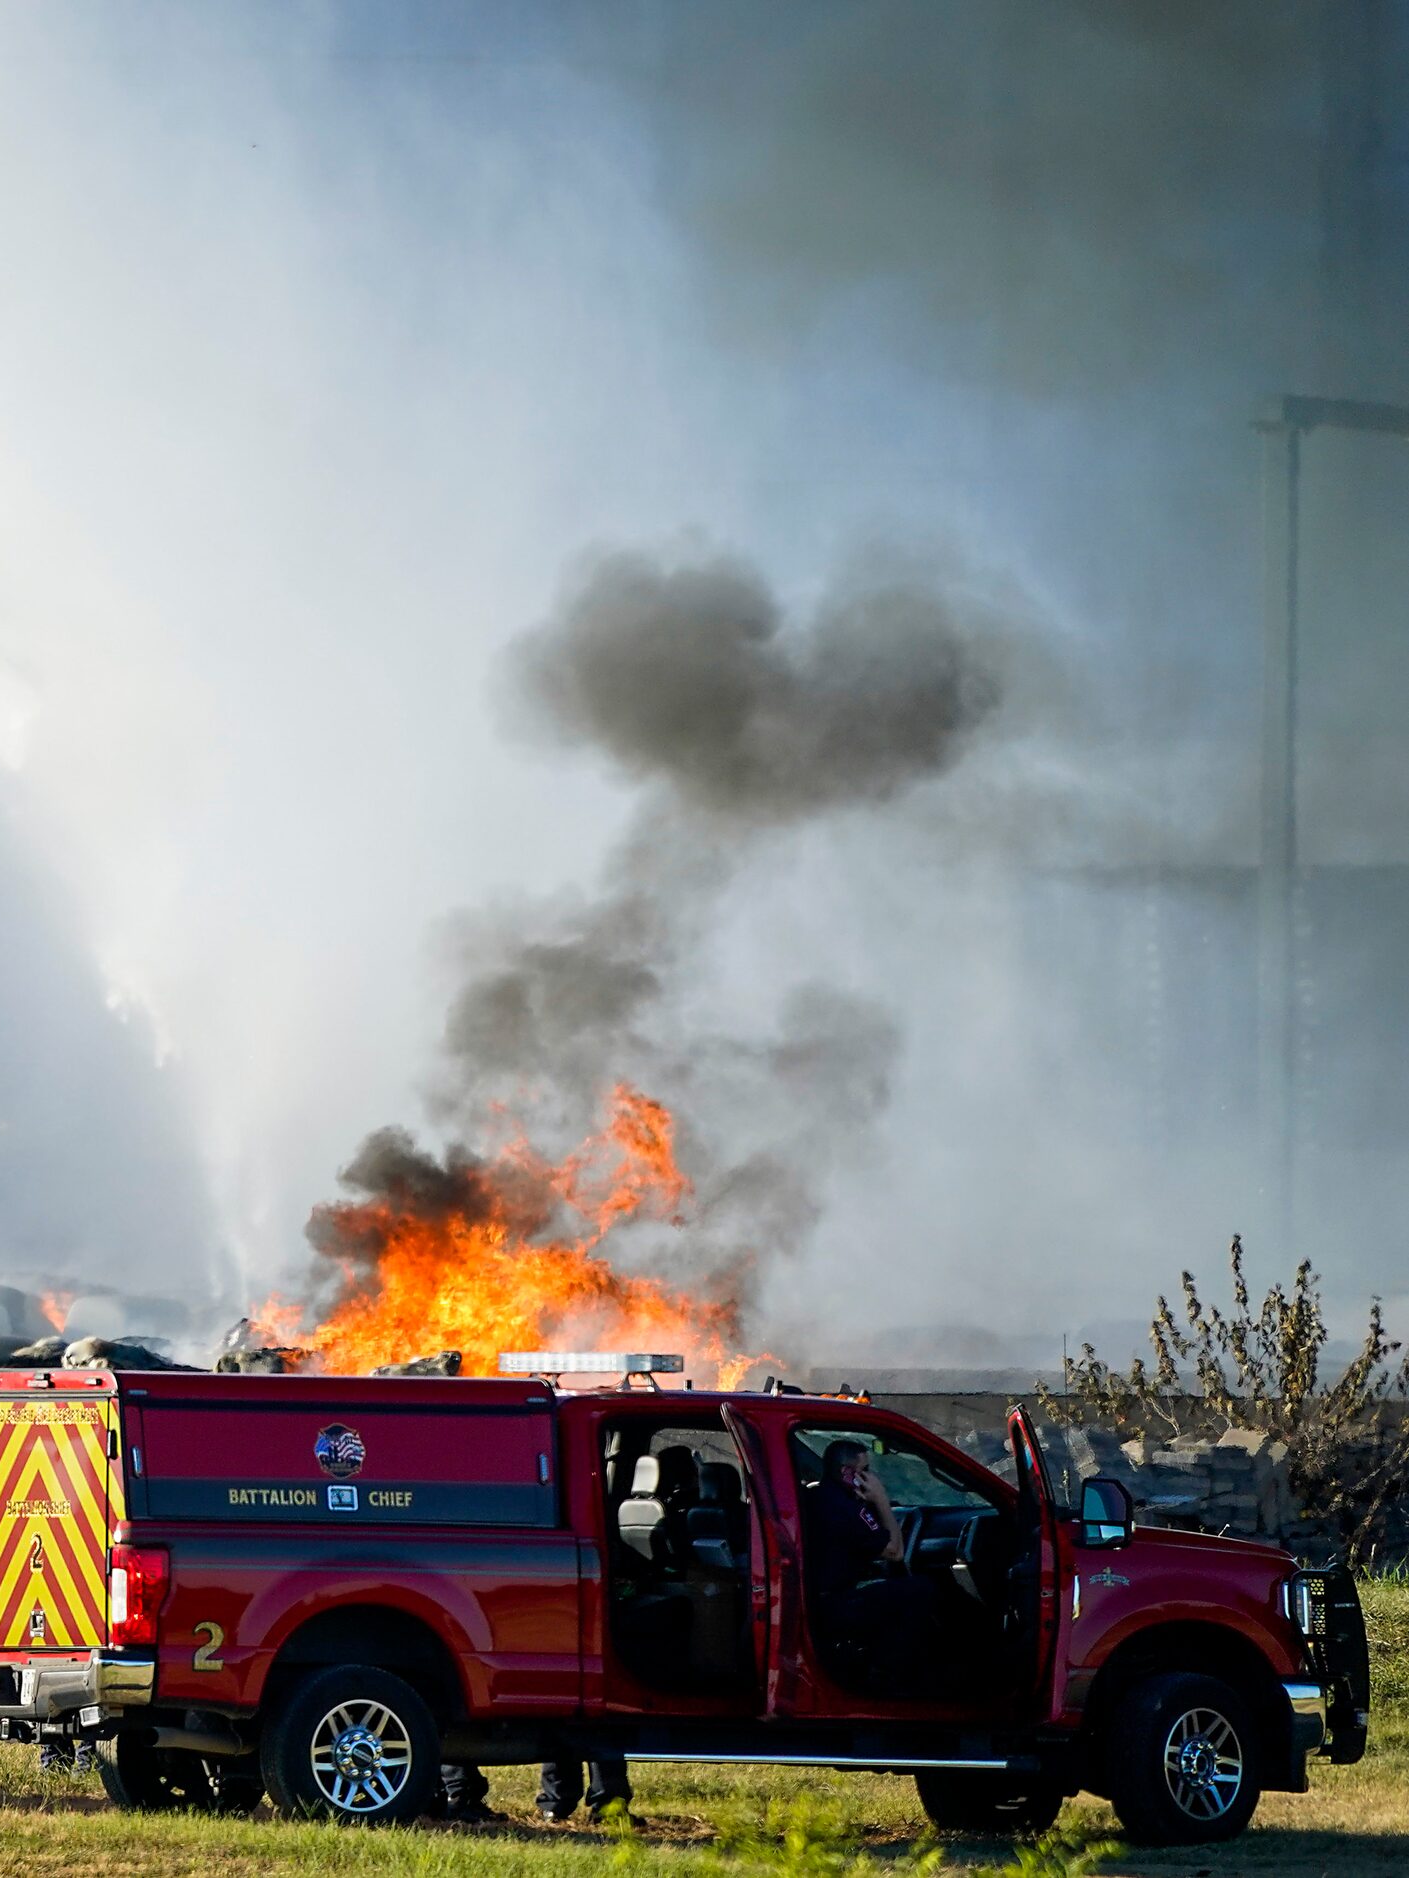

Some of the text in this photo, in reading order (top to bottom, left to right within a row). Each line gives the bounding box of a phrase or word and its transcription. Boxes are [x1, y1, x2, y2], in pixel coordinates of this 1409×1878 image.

[229, 1488, 413, 1507] BATTALION CHIEF
[31, 1533, 43, 1570] 2
[193, 1621, 225, 1672] 2
